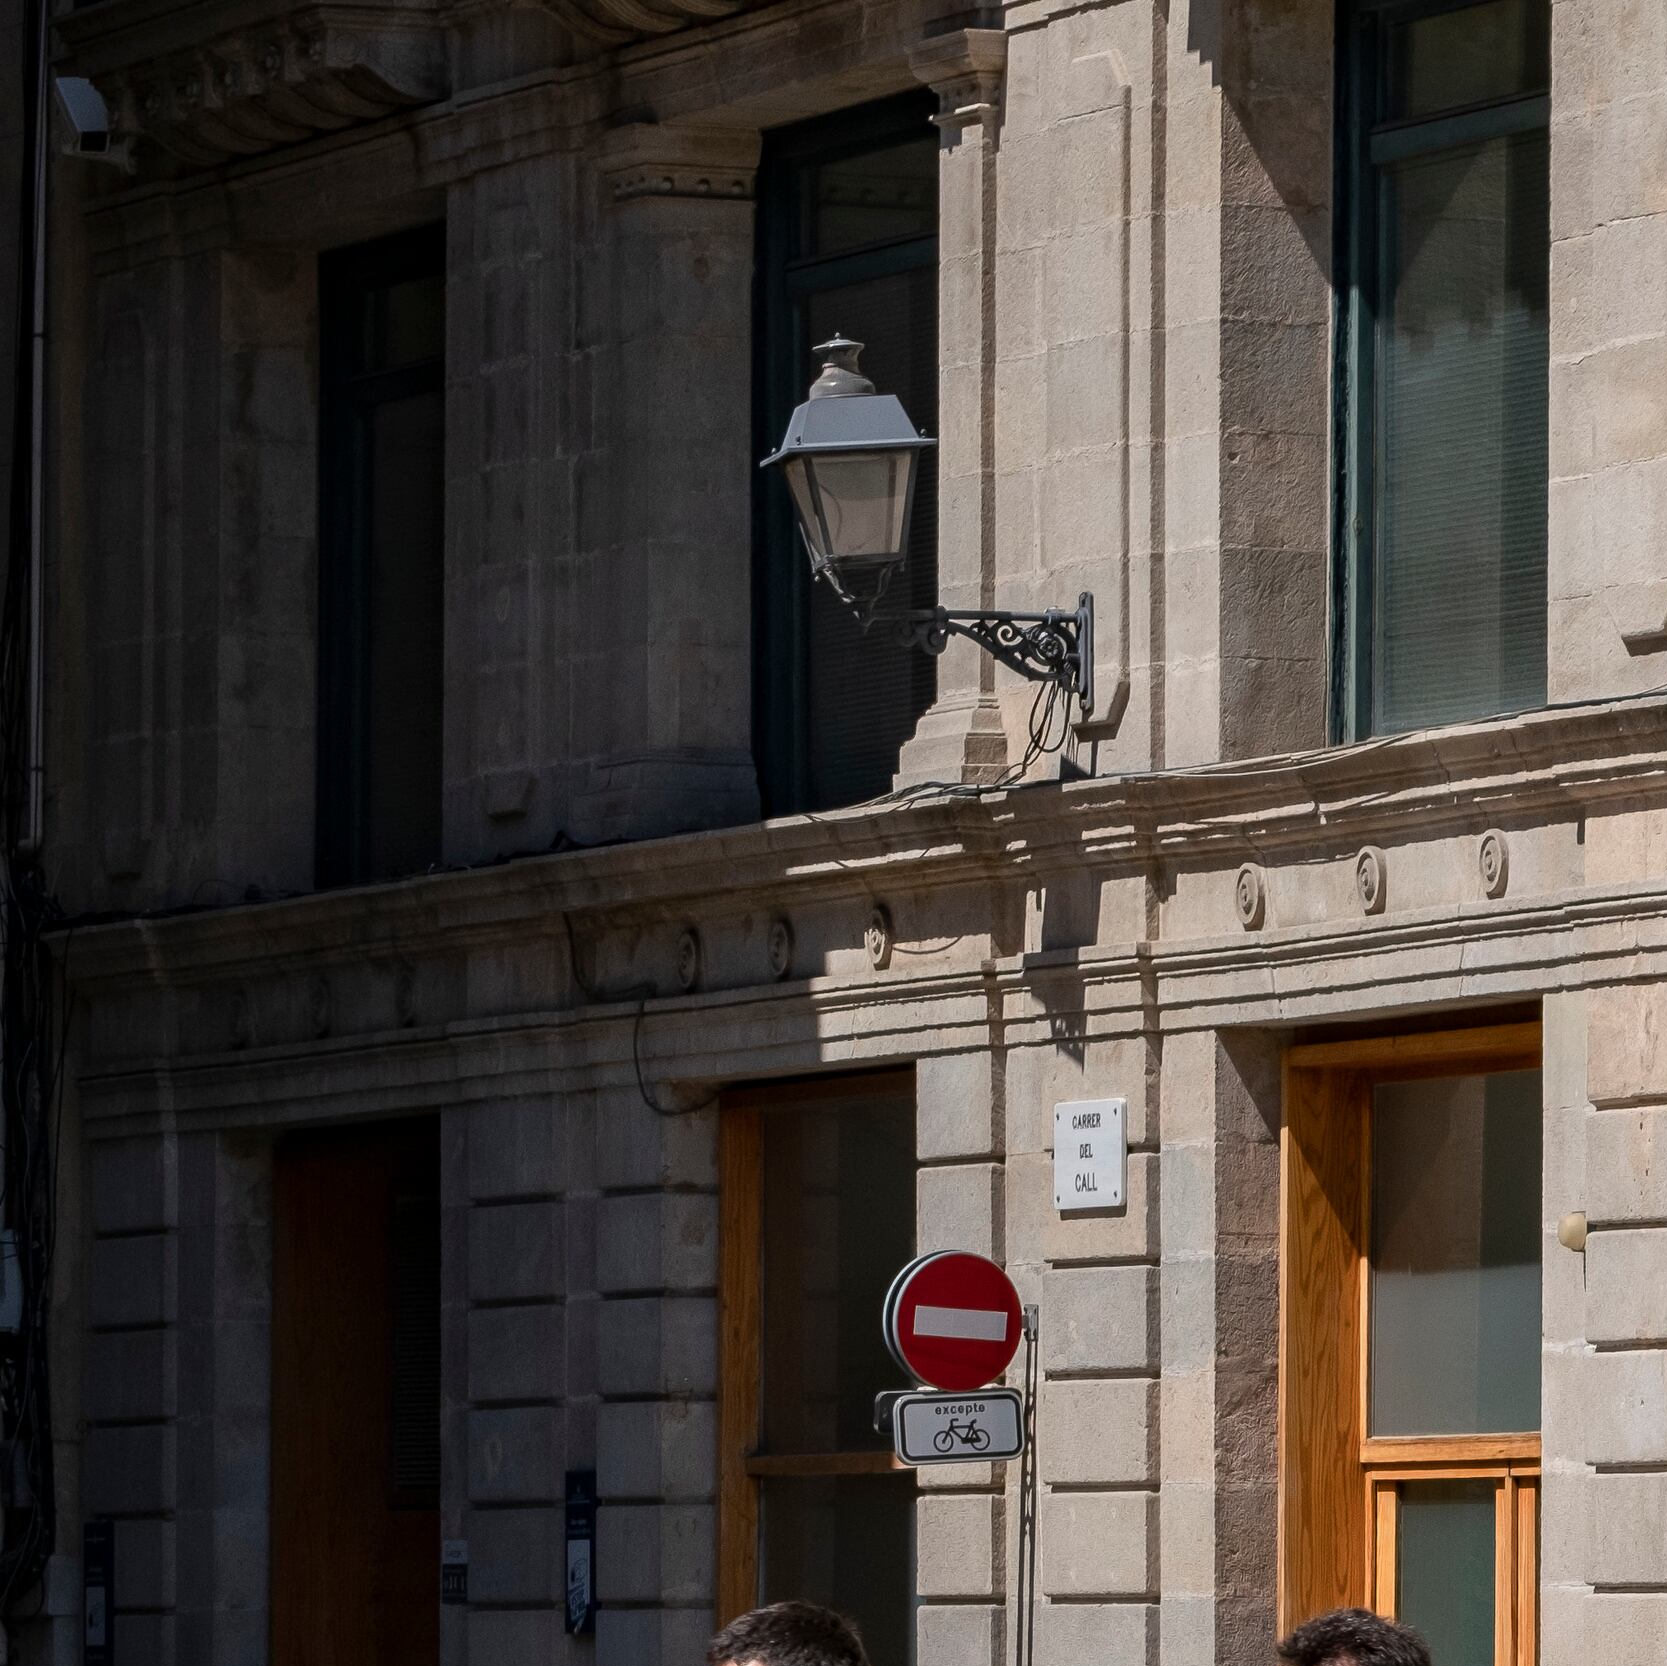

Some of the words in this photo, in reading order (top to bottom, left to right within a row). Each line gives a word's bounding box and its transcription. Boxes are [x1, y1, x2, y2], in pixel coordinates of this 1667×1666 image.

[1072, 1113, 1101, 1129] CARRER
[1080, 1143, 1093, 1159] DEL
[1075, 1172, 1098, 1192] CALL
[935, 1402, 985, 1416] excepte
